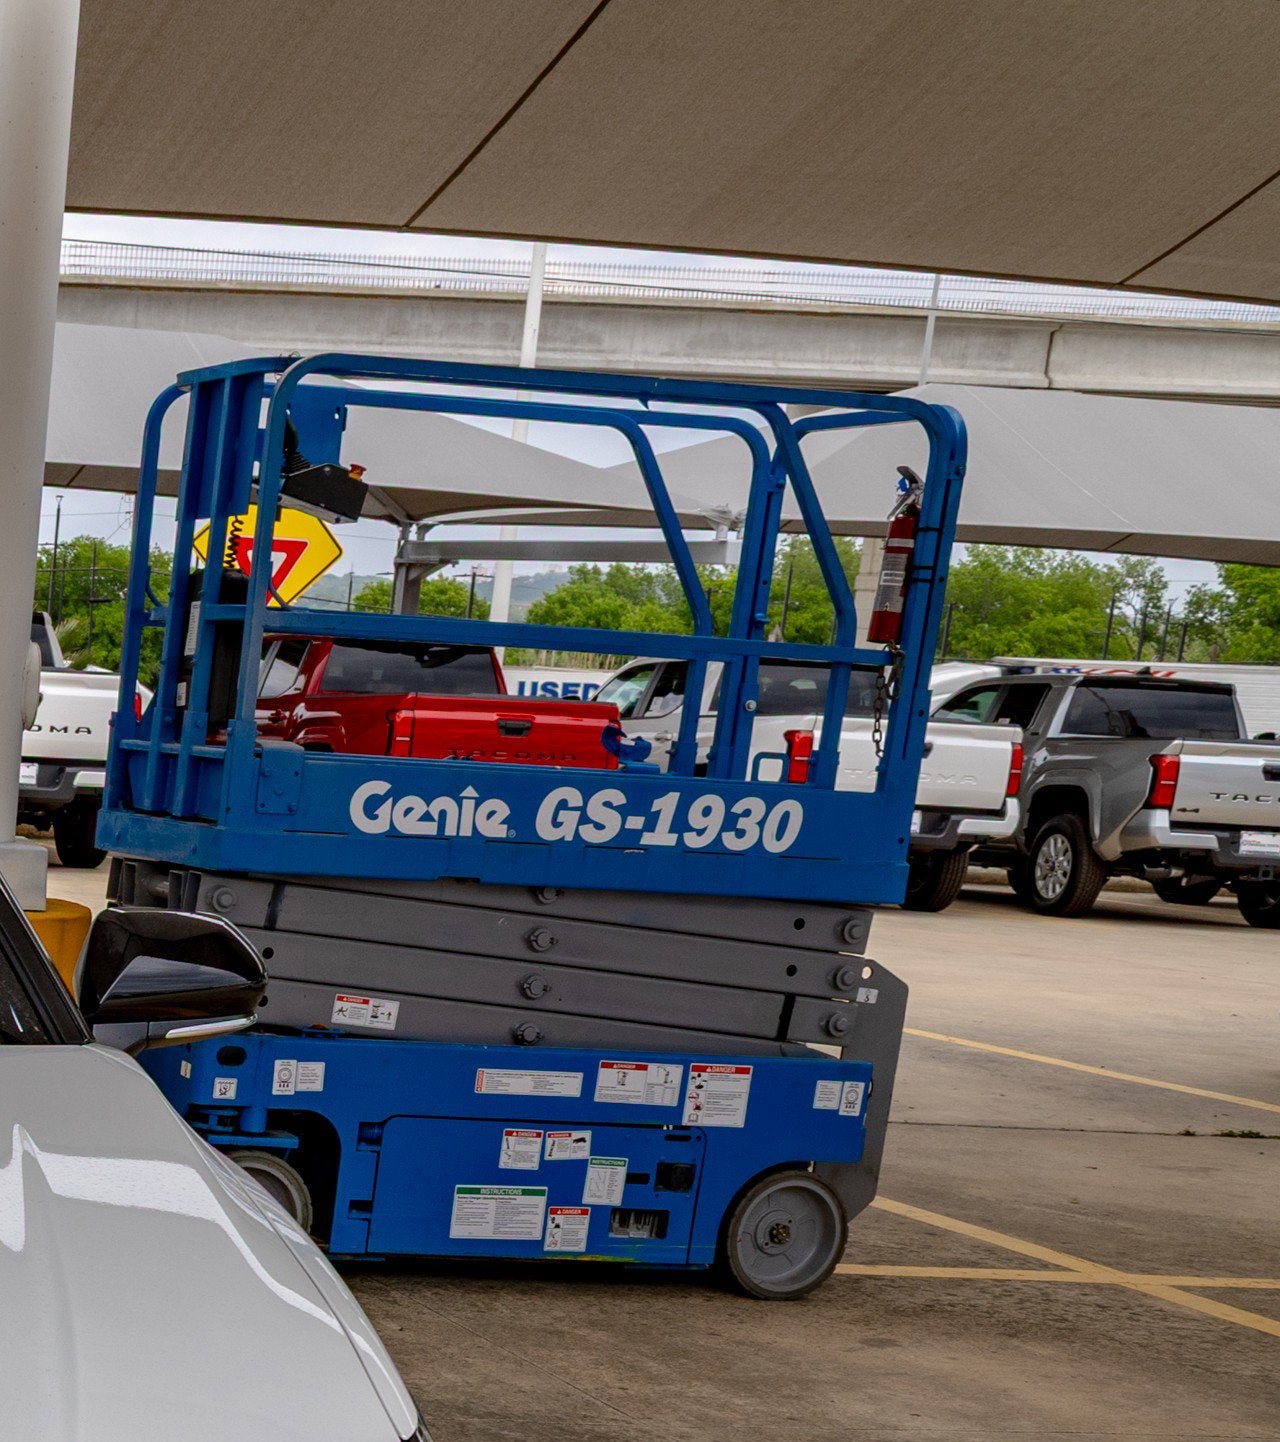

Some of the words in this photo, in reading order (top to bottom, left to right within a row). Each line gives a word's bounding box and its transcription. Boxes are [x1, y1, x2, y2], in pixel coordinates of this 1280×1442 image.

[349, 780, 511, 838] Genie
[535, 785, 804, 854] GS-1930
[480, 1188, 522, 1196] INSTRUCTIONS
